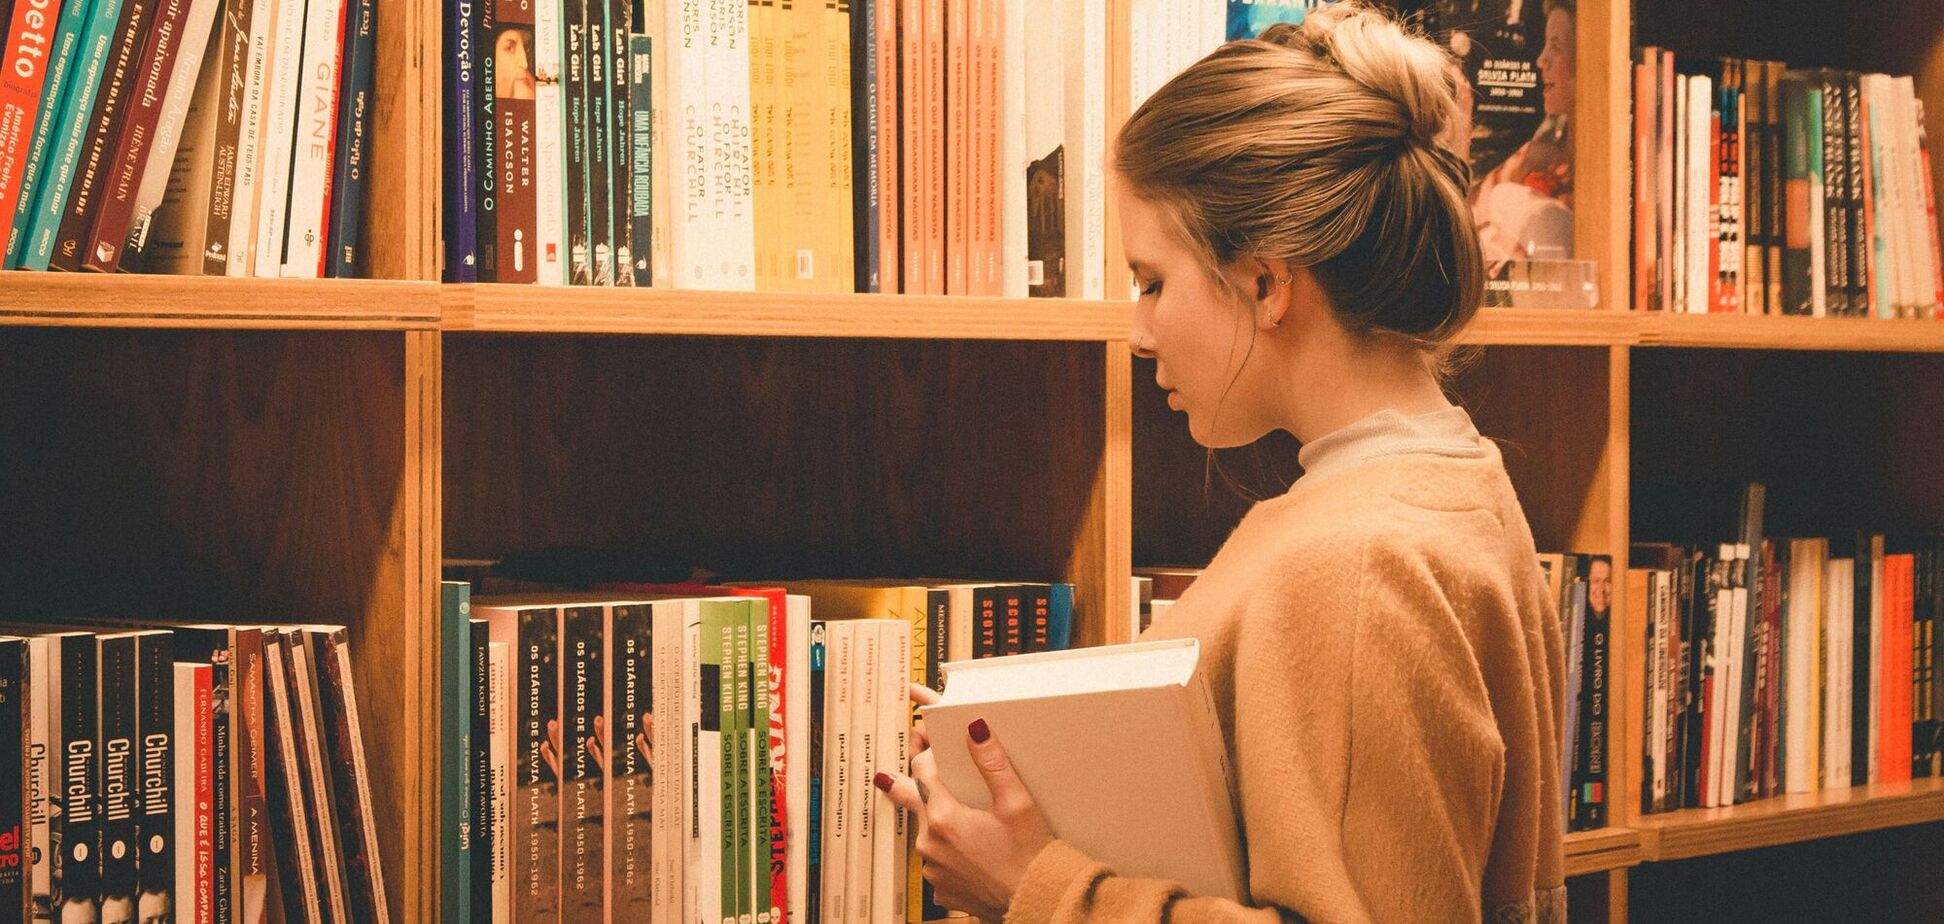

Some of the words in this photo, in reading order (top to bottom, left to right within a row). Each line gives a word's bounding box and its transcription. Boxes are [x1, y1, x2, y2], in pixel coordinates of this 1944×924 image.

[15, 0, 49, 78] etto
[62, 32, 75, 55] Uma
[93, 34, 108, 59] Uma
[105, 3, 143, 114] ENCRUZILHADAS
[458, 1, 472, 83] Devoção
[570, 24, 579, 51] Lab
[591, 24, 601, 51] Lab
[615, 27, 625, 55] Lab
[47, 57, 65, 109] esperança
[80, 58, 99, 112] esperança
[141, 21, 174, 108] apaixonada
[252, 51, 263, 86] EMBORA
[484, 56, 494, 115] ABERTO
[571, 53, 580, 82] Girl
[592, 53, 602, 82] Girl
[616, 58, 626, 86] Girl
[884, 55, 892, 101] MENINOS
[911, 58, 919, 103] MENINOS
[930, 58, 938, 102] MENINOS
[955, 61, 963, 107] MENINOS
[990, 61, 998, 106] MENINOS
[1477, 69, 1507, 81] SYLVIA
[1510, 70, 1537, 83] PLATH
[8, 106, 24, 154] Américo
[249, 104, 258, 127] CASA
[310, 63, 332, 160] GIANE
[573, 96, 581, 123] Hope
[594, 96, 603, 123] Hope
[618, 99, 627, 127] Hope
[634, 110, 649, 131] UMA
[884, 104, 892, 124] QUE
[911, 106, 919, 126] QUE
[930, 105, 938, 126] QUE
[955, 110, 963, 129] QUE
[989, 110, 997, 129] QUE
[483, 120, 494, 192] CAMINHO
[505, 111, 514, 194] ISAACSON
[521, 120, 529, 187] WALTER
[595, 125, 603, 163] Jahren
[619, 129, 627, 166] Jahren
[634, 133, 651, 174] INFÂNCIA
[884, 128, 892, 190] ENGANAVAM
[911, 130, 919, 193] ENGANAVAM
[930, 129, 938, 191] ENGANAVAM
[955, 133, 963, 196] ENGANAVAM
[989, 133, 997, 197] ENGANAVAM
[0, 155, 15, 190] Freire
[75, 137, 104, 216] LIBERDADE
[116, 164, 134, 202] FRAIN
[697, 145, 706, 198] FATOR
[723, 142, 733, 194] FATOR
[741, 145, 751, 197] FATOR
[869, 152, 879, 208] MEMÓRIA
[221, 176, 231, 219] EDWARD
[484, 197, 494, 211] O
[633, 175, 650, 217] ROUBADA
[884, 192, 892, 240] NAZISTAS
[930, 194, 938, 240] NAZISTAS
[911, 195, 919, 241] NAZISTAS
[955, 198, 963, 243] NAZISTAS
[989, 199, 997, 242] NAZISTAS
[982, 600, 994, 646] SCOTT
[1007, 598, 1019, 645] SCOTT
[1035, 598, 1047, 644] SCOTT
[1594, 633, 1605, 645] O
[478, 646, 486, 684] FAWZIA
[531, 645, 538, 659] OS
[576, 641, 584, 656] OS
[627, 639, 635, 654] OS
[722, 626, 733, 679] STEPHEN
[737, 625, 748, 678] STEPHEN
[756, 624, 768, 677] STEPHEN
[839, 636, 849, 675] Kfouri
[864, 638, 874, 675] Kfouri
[913, 607, 926, 686] AMYR
[249, 653, 257, 727] SAMANTHA
[531, 665, 540, 716] DIÁRIOS
[576, 661, 586, 712] DIÁRIOS
[627, 659, 637, 710] DIÁRIOS
[1592, 648, 1604, 690] LIVRO
[478, 685, 486, 717] KOOFI
[722, 683, 733, 712] KING
[737, 681, 748, 710] KING
[756, 680, 768, 709] KING
[839, 680, 849, 703] Juca
[864, 681, 874, 703] Juca
[1592, 692, 1602, 715] DO
[200, 688, 208, 746] FERNANDO
[531, 721, 538, 736] DE
[576, 717, 584, 732] DE
[627, 714, 635, 728] DE
[217, 725, 226, 757] Minha
[249, 729, 258, 778] GEIMER
[576, 736, 584, 777] SYLVIA
[627, 732, 635, 774] SYLVIA
[724, 733, 734, 777] SOBRE
[738, 731, 749, 774] SOBRE
[759, 730, 768, 774] SOBRE
[837, 733, 846, 759] perdi
[862, 733, 871, 759] perdi
[897, 731, 906, 762] perdi
[68, 739, 92, 823] Churchill
[108, 738, 130, 821] Churchill
[144, 733, 168, 816] Churchill
[200, 747, 208, 792] GABEIRA
[218, 760, 227, 779] vida
[479, 760, 487, 788] FILHA
[837, 764, 846, 787] que
[862, 764, 871, 786] que
[218, 782, 226, 810] como
[479, 790, 487, 838] FAVORITA
[576, 782, 584, 819] PLATH
[627, 779, 635, 816] PLATH
[759, 790, 768, 844] ESCRITA
[836, 789, 845, 838] Confesso
[861, 789, 870, 838] Confesso
[199, 815, 208, 836] QUE
[218, 812, 227, 850] traidora
[724, 794, 734, 850] ESCRITA
[738, 791, 749, 848] ESCRITA
[251, 821, 260, 876] MENINA
[576, 826, 584, 890] 1950-1962
[627, 820, 635, 886] 1950-1962
[198, 880, 210, 924] COMPAN
[218, 866, 228, 901] Zarah
